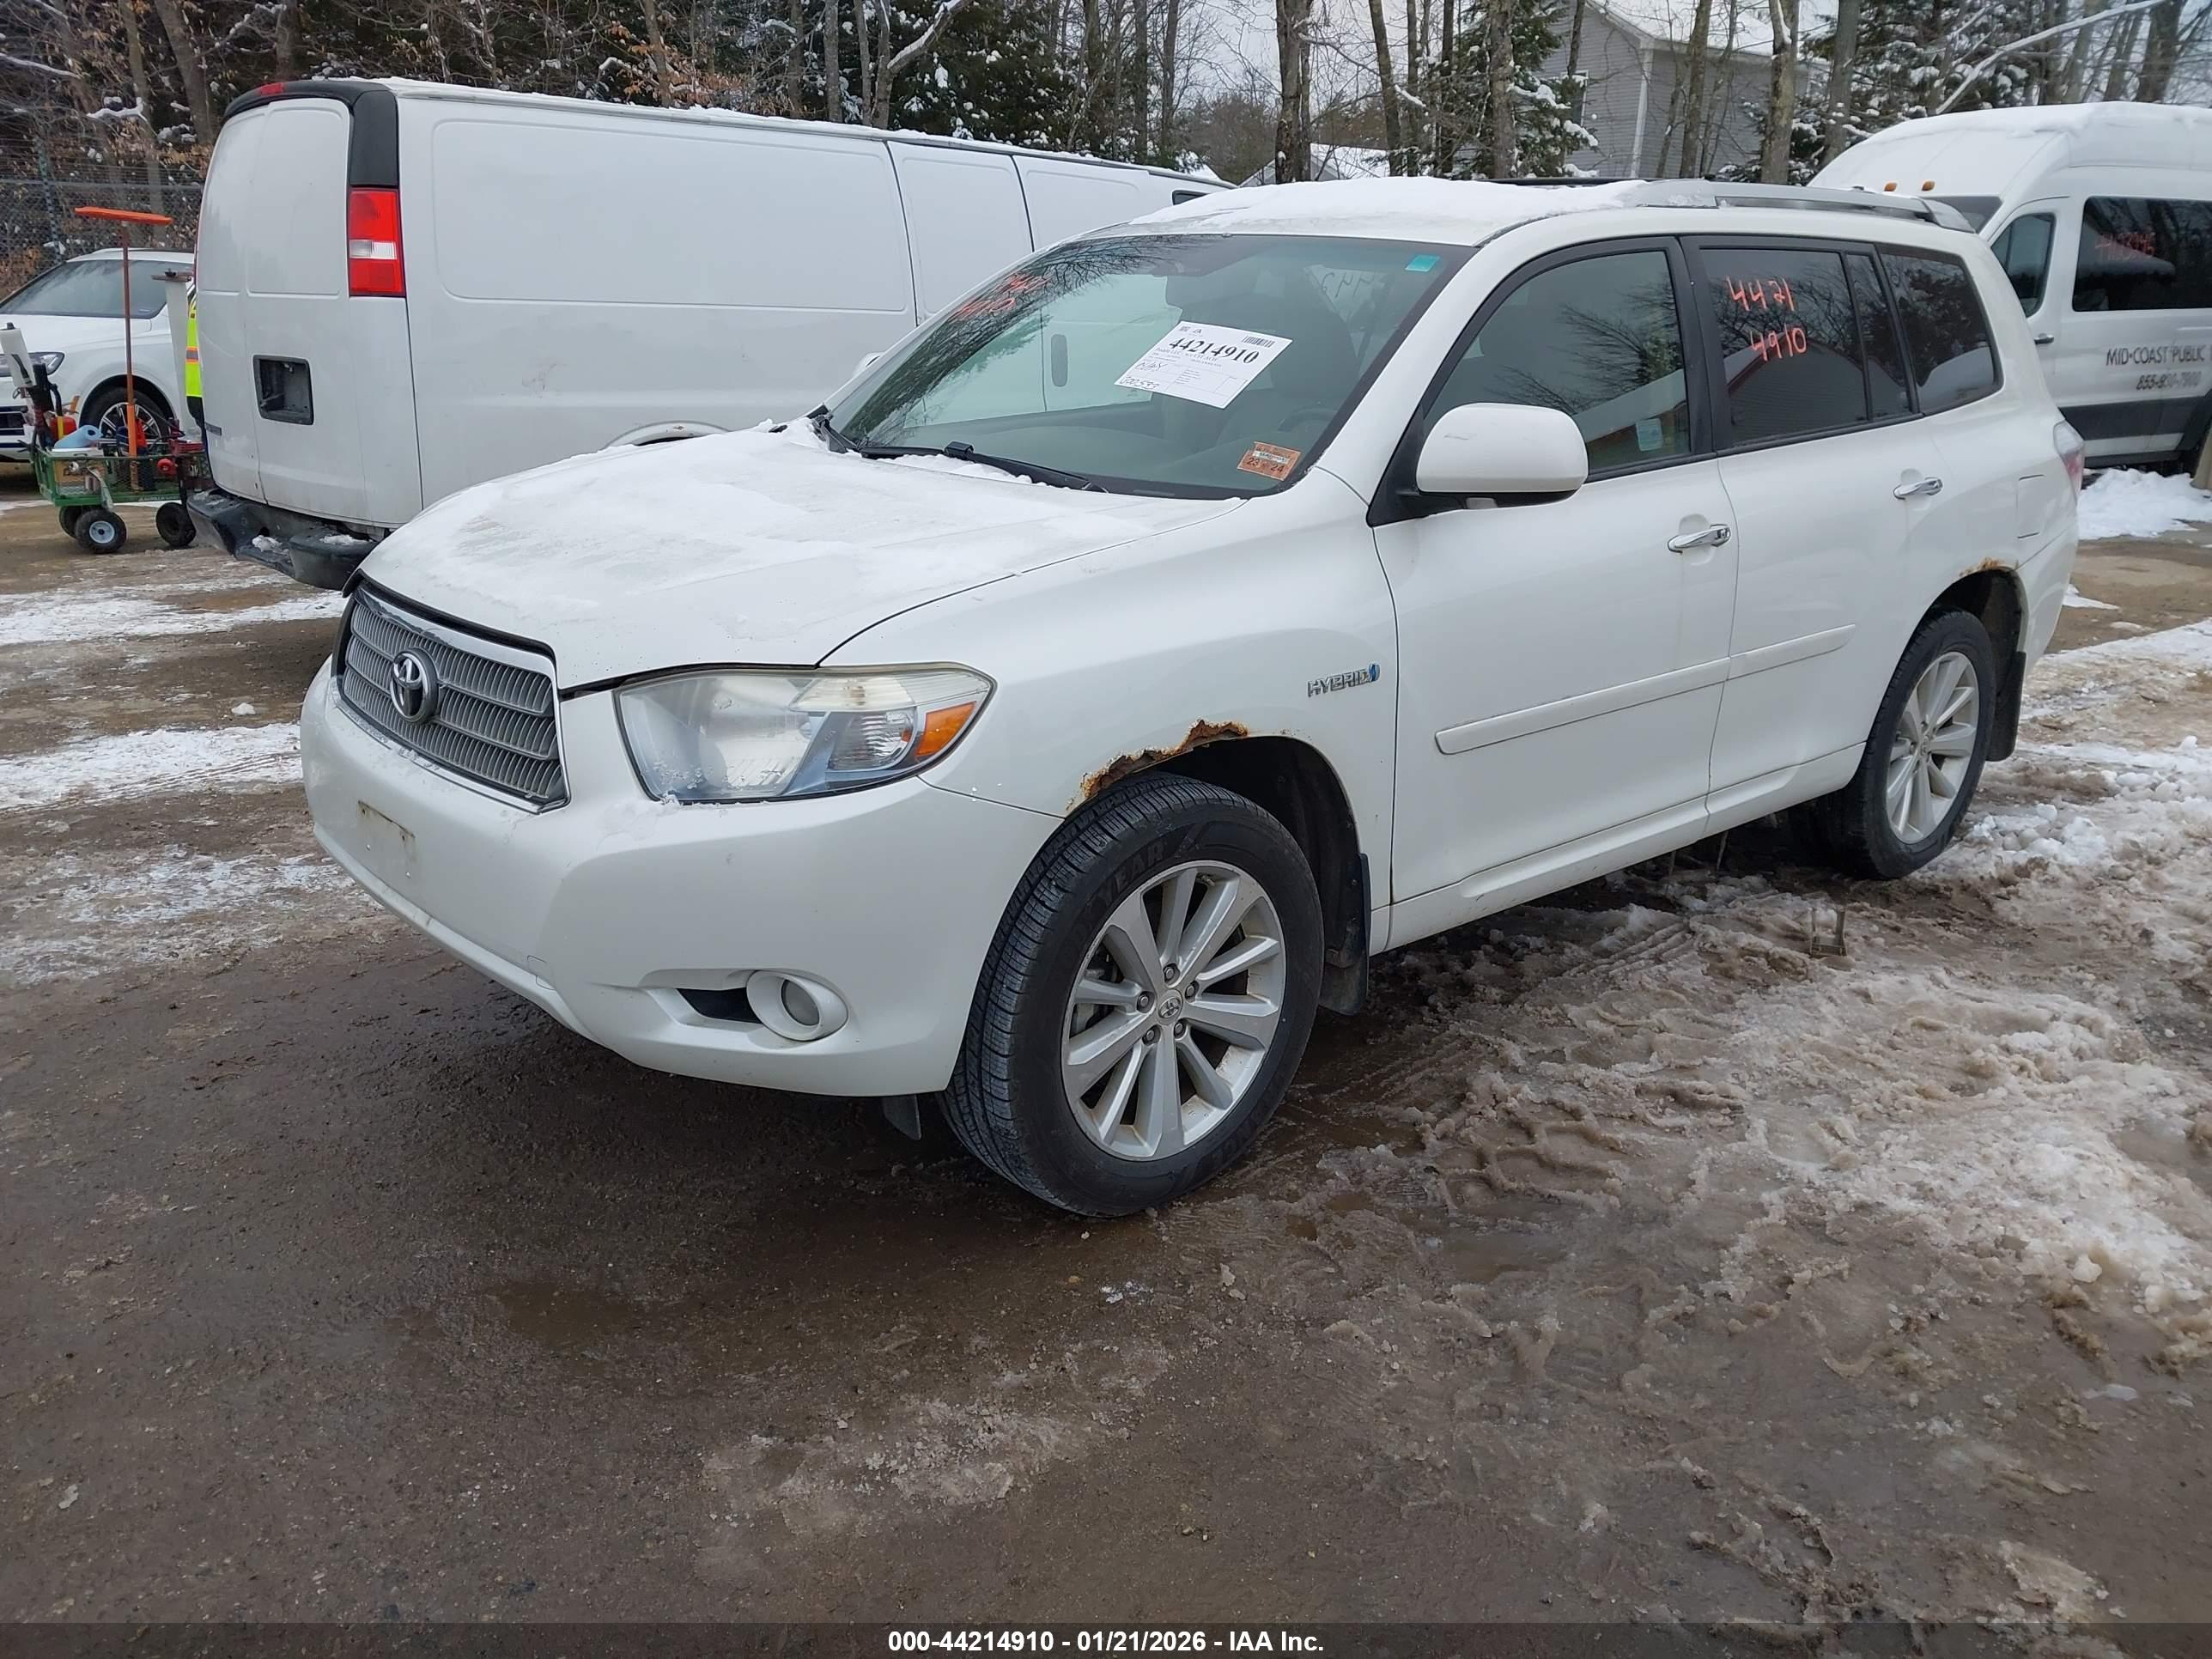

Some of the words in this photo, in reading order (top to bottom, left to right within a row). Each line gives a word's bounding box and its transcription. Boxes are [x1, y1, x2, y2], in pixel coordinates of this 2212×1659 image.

[1168, 337, 1261, 364] 44214910
[1750, 323, 1807, 362] 4910
[2172, 343, 2206, 362] PUBLIC
[1307, 668, 1371, 697] HYBRID
